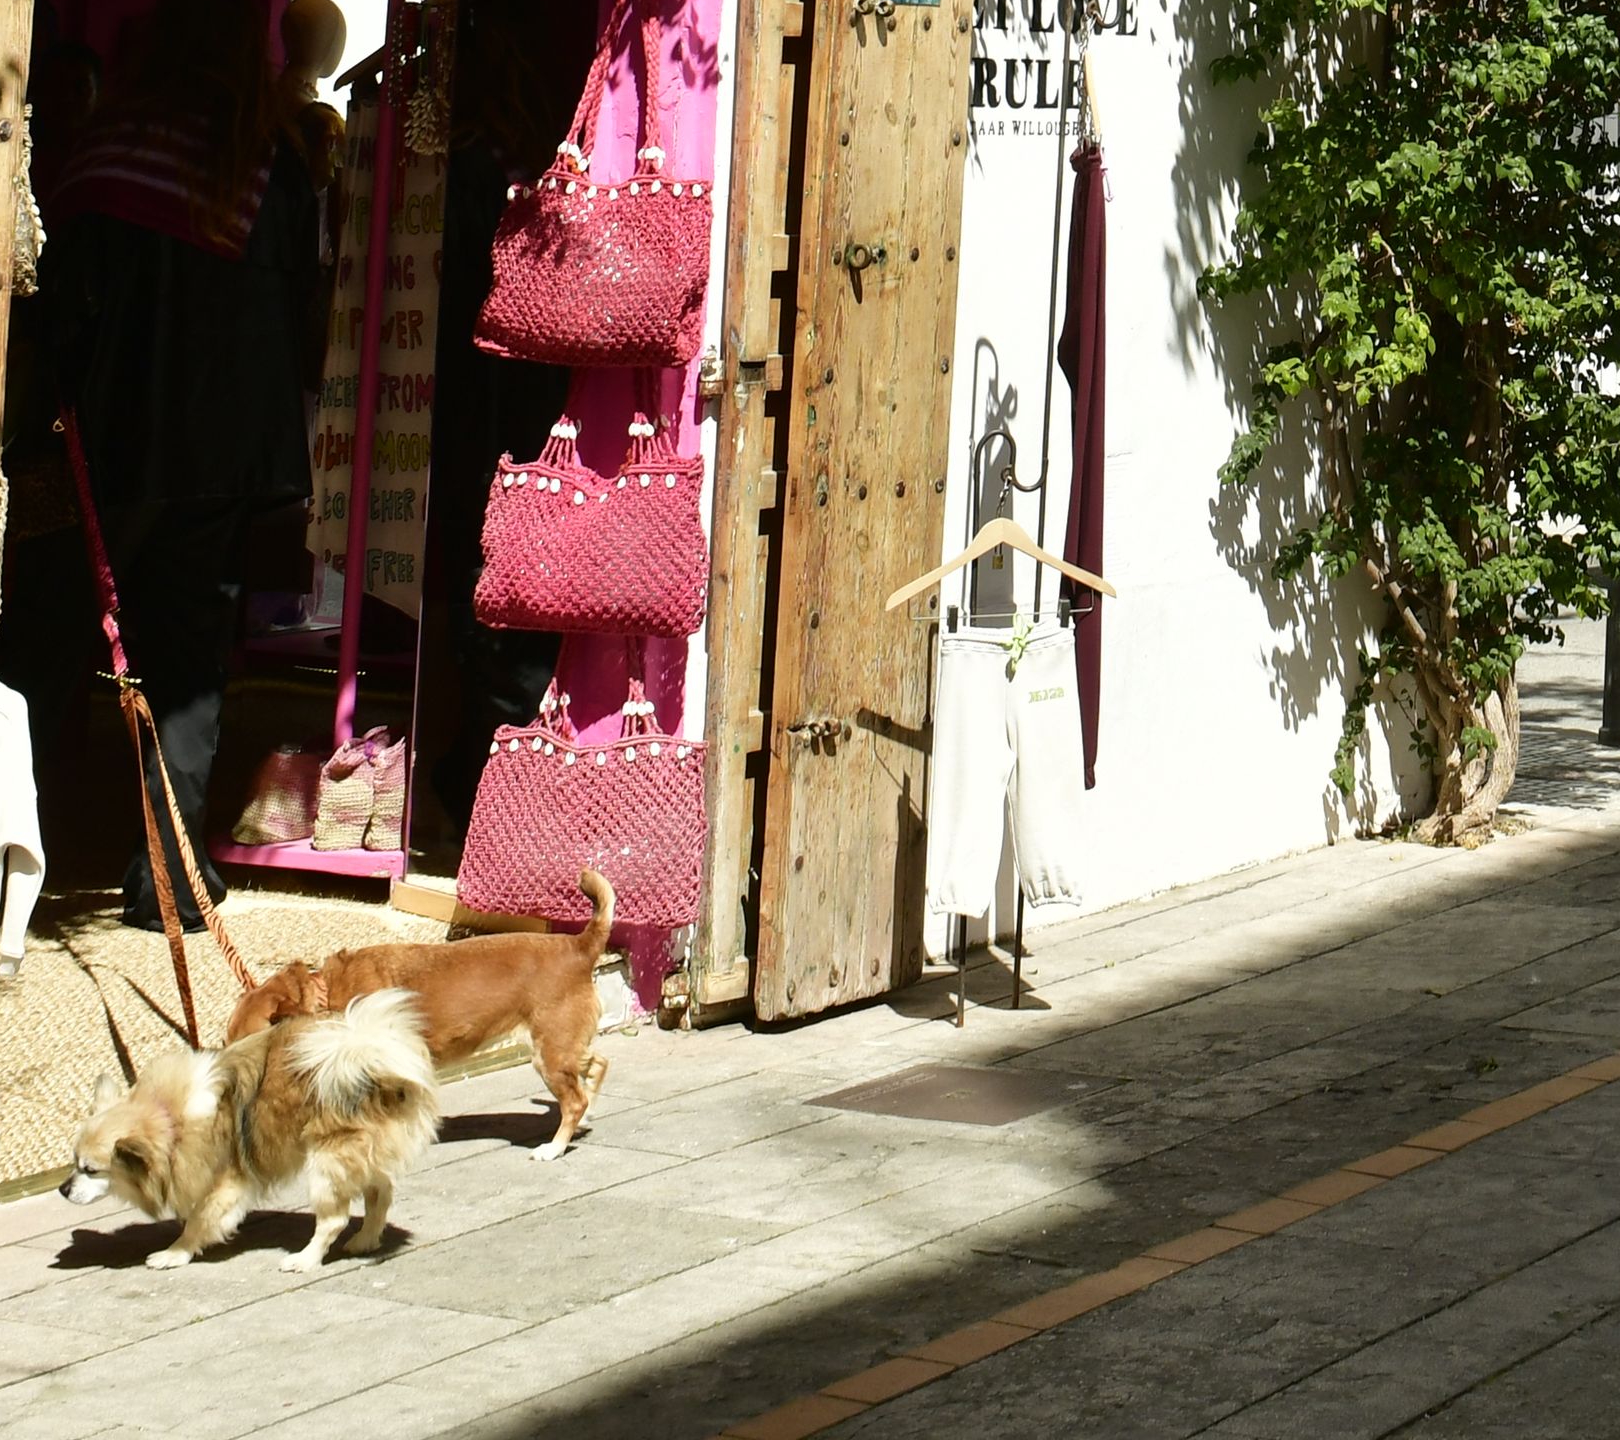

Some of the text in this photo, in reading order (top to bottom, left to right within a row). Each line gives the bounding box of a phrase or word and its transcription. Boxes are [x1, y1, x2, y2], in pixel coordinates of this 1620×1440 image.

[969, 57, 1083, 110] RULE
[970, 120, 1088, 136] TAAR WILLOUGH
